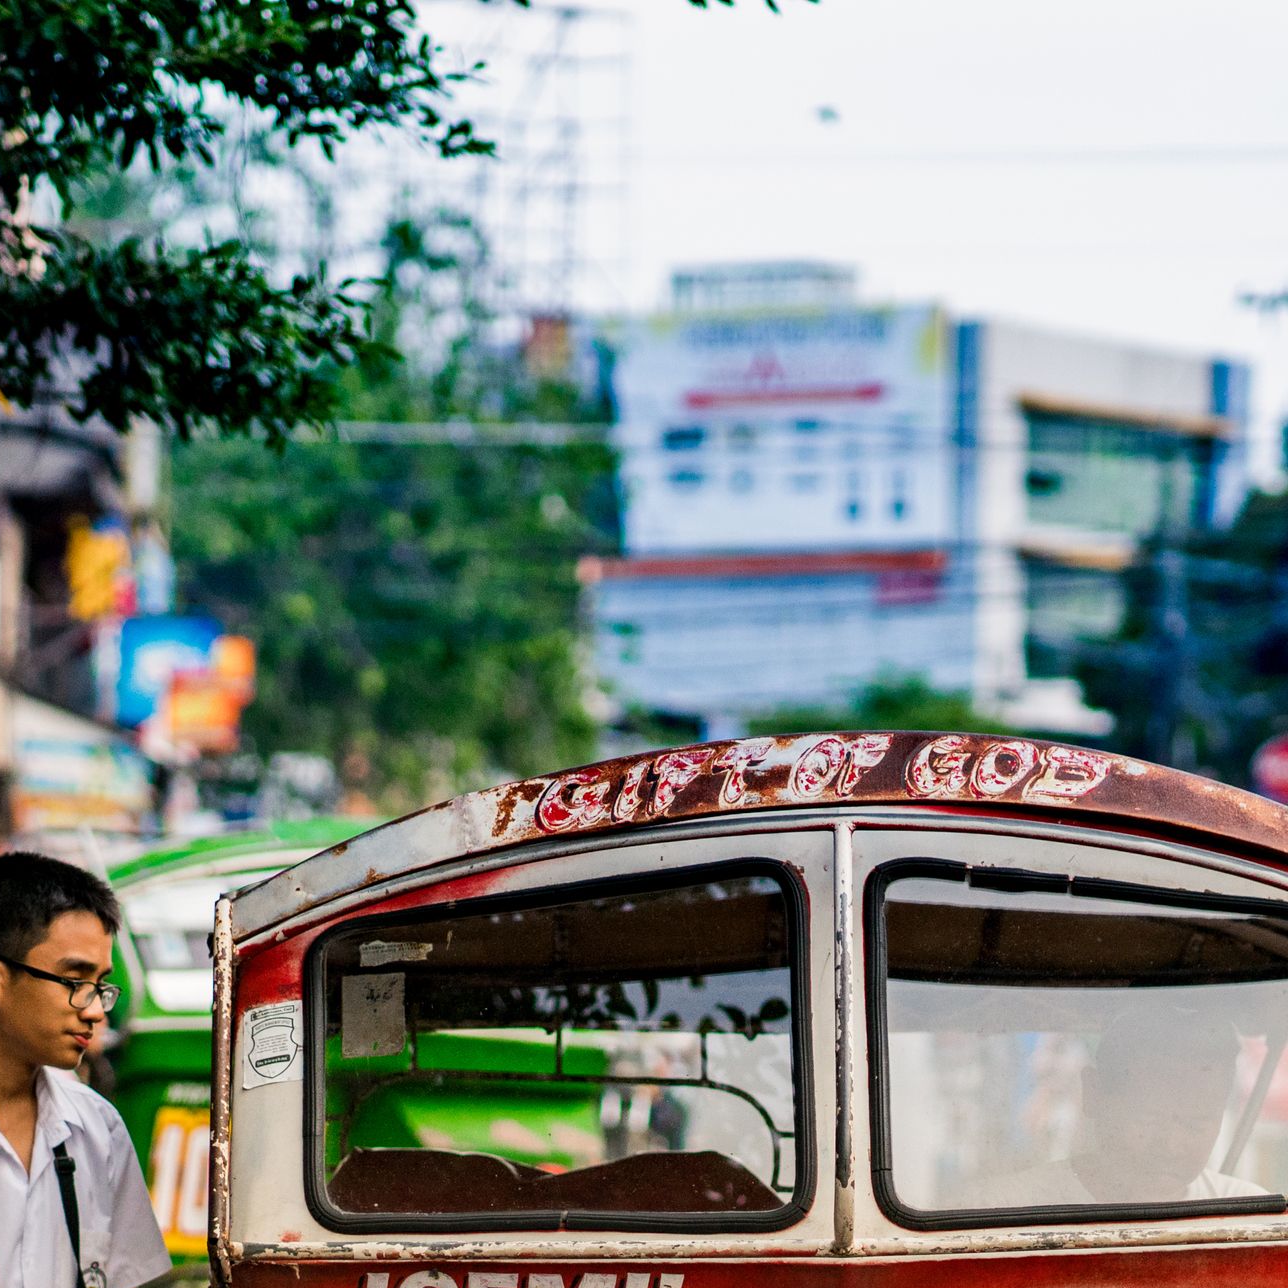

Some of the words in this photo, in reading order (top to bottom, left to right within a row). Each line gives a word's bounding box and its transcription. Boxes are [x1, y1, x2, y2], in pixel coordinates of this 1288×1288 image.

[536, 737, 776, 833] GIFT
[789, 732, 894, 800] OF
[906, 734, 1115, 800] GOD
